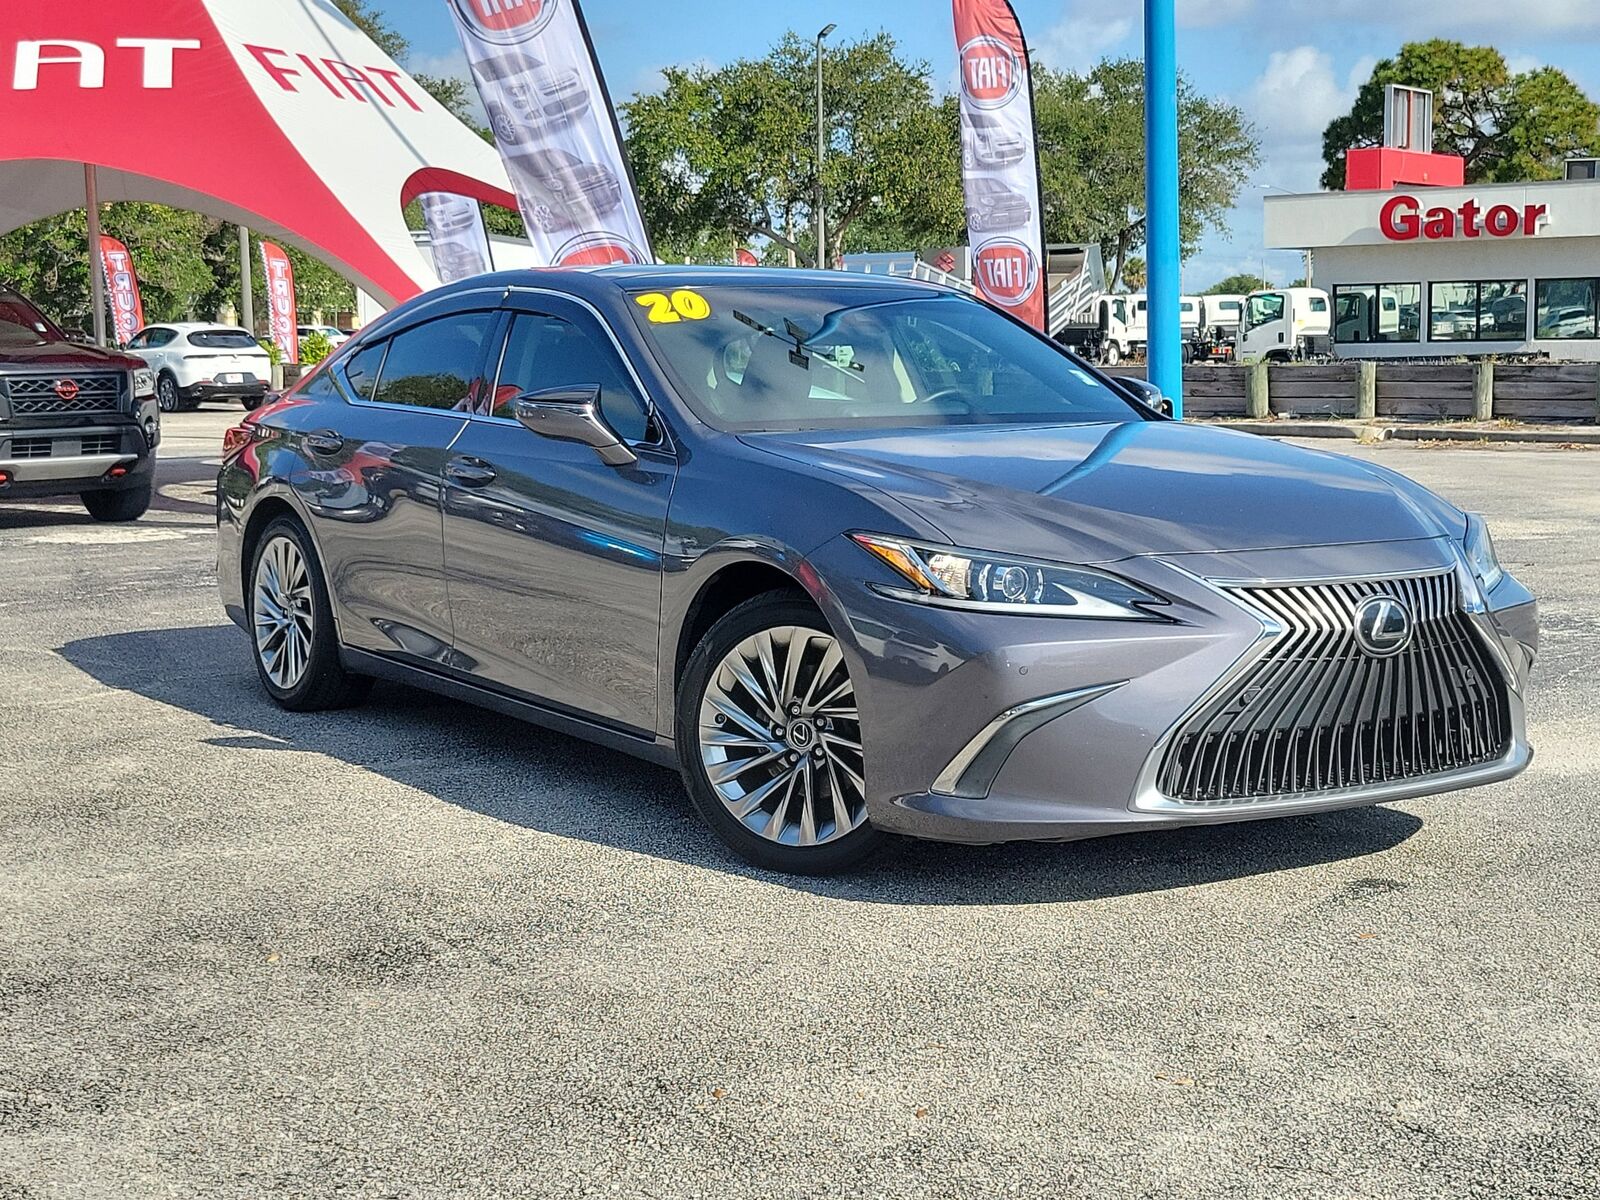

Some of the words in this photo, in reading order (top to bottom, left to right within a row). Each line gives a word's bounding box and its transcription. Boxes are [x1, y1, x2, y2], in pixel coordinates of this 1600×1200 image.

[242, 43, 424, 113] FIAT
[1379, 195, 1547, 241] Gator
[635, 289, 711, 324] 20
